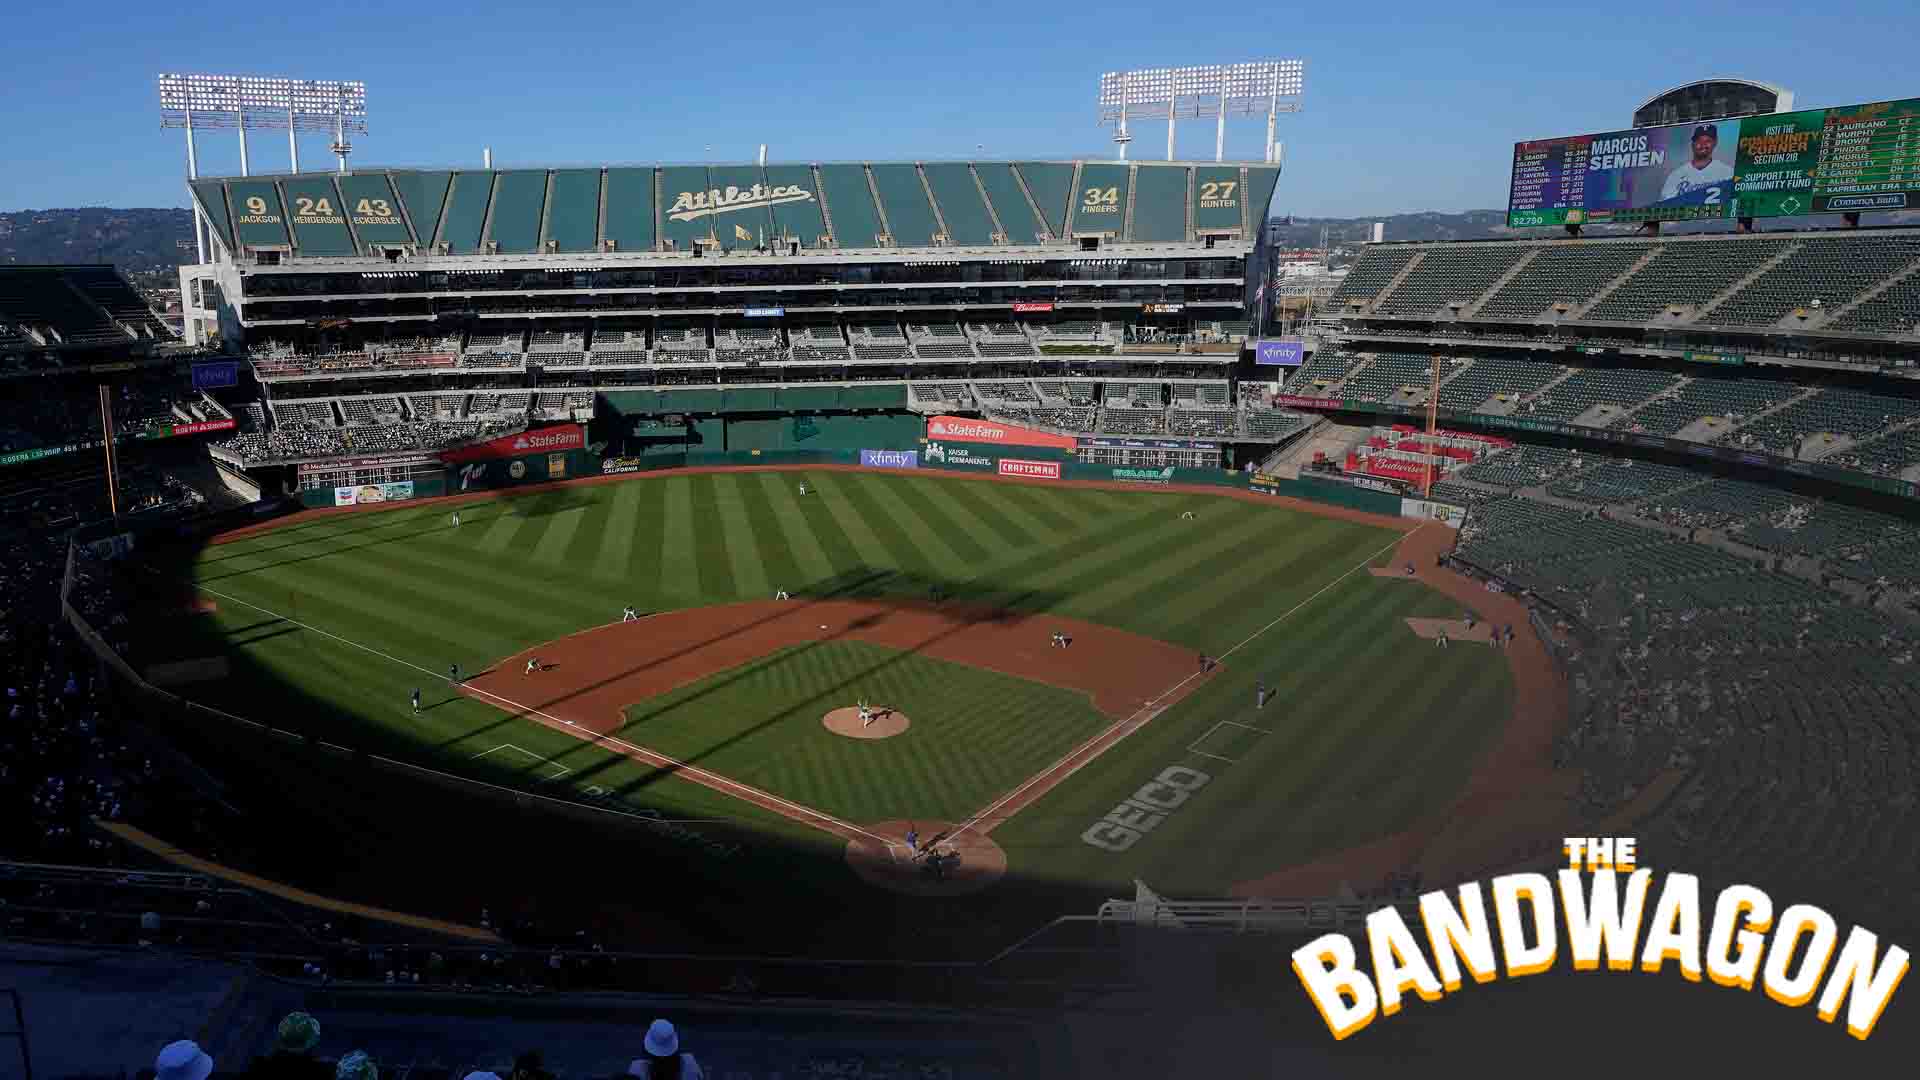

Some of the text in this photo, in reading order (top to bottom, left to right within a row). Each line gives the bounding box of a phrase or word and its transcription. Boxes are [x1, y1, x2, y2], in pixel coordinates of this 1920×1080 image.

[1837, 121, 1887, 131] LAUREANO
[1836, 129, 1876, 138] MURPHY
[1591, 136, 1648, 155] MARCUS
[1834, 138, 1870, 146] BROWN
[1833, 145, 1867, 153] PINDER
[1590, 151, 1664, 170] SEMIEN
[1753, 154, 1784, 165] SECTION
[1832, 152, 1870, 160] ANDRUS
[1745, 170, 1801, 182] SUPPORT THE
[1201, 182, 1237, 200] 27
[1735, 178, 1811, 191] COMMUNITY FUND
[665, 183, 812, 217] Athletics
[1084, 187, 1119, 205] 34
[1704, 187, 1721, 204] 2
[246, 196, 267, 215] 9
[296, 197, 333, 215] 24
[356, 198, 392, 216] 43
[1082, 205, 1118, 213] FINGERS
[1200, 200, 1236, 208] HUNTER
[240, 215, 280, 224] JACKSON
[293, 216, 344, 224] HENDERSON
[354, 216, 401, 224] ECKERSLEY
[1263, 347, 1297, 360] xfinity
[948, 423, 1004, 439] StateFarm
[529, 433, 580, 448] StateFarm
[869, 450, 908, 466] xfinity
[949, 449, 968, 457] KAISER
[948, 456, 992, 467] PERMANENTE
[604, 466, 638, 474] CALIFORNIA
[1002, 463, 1057, 476] CRAFTSMAN
[1080, 766, 1211, 852] GEICO
